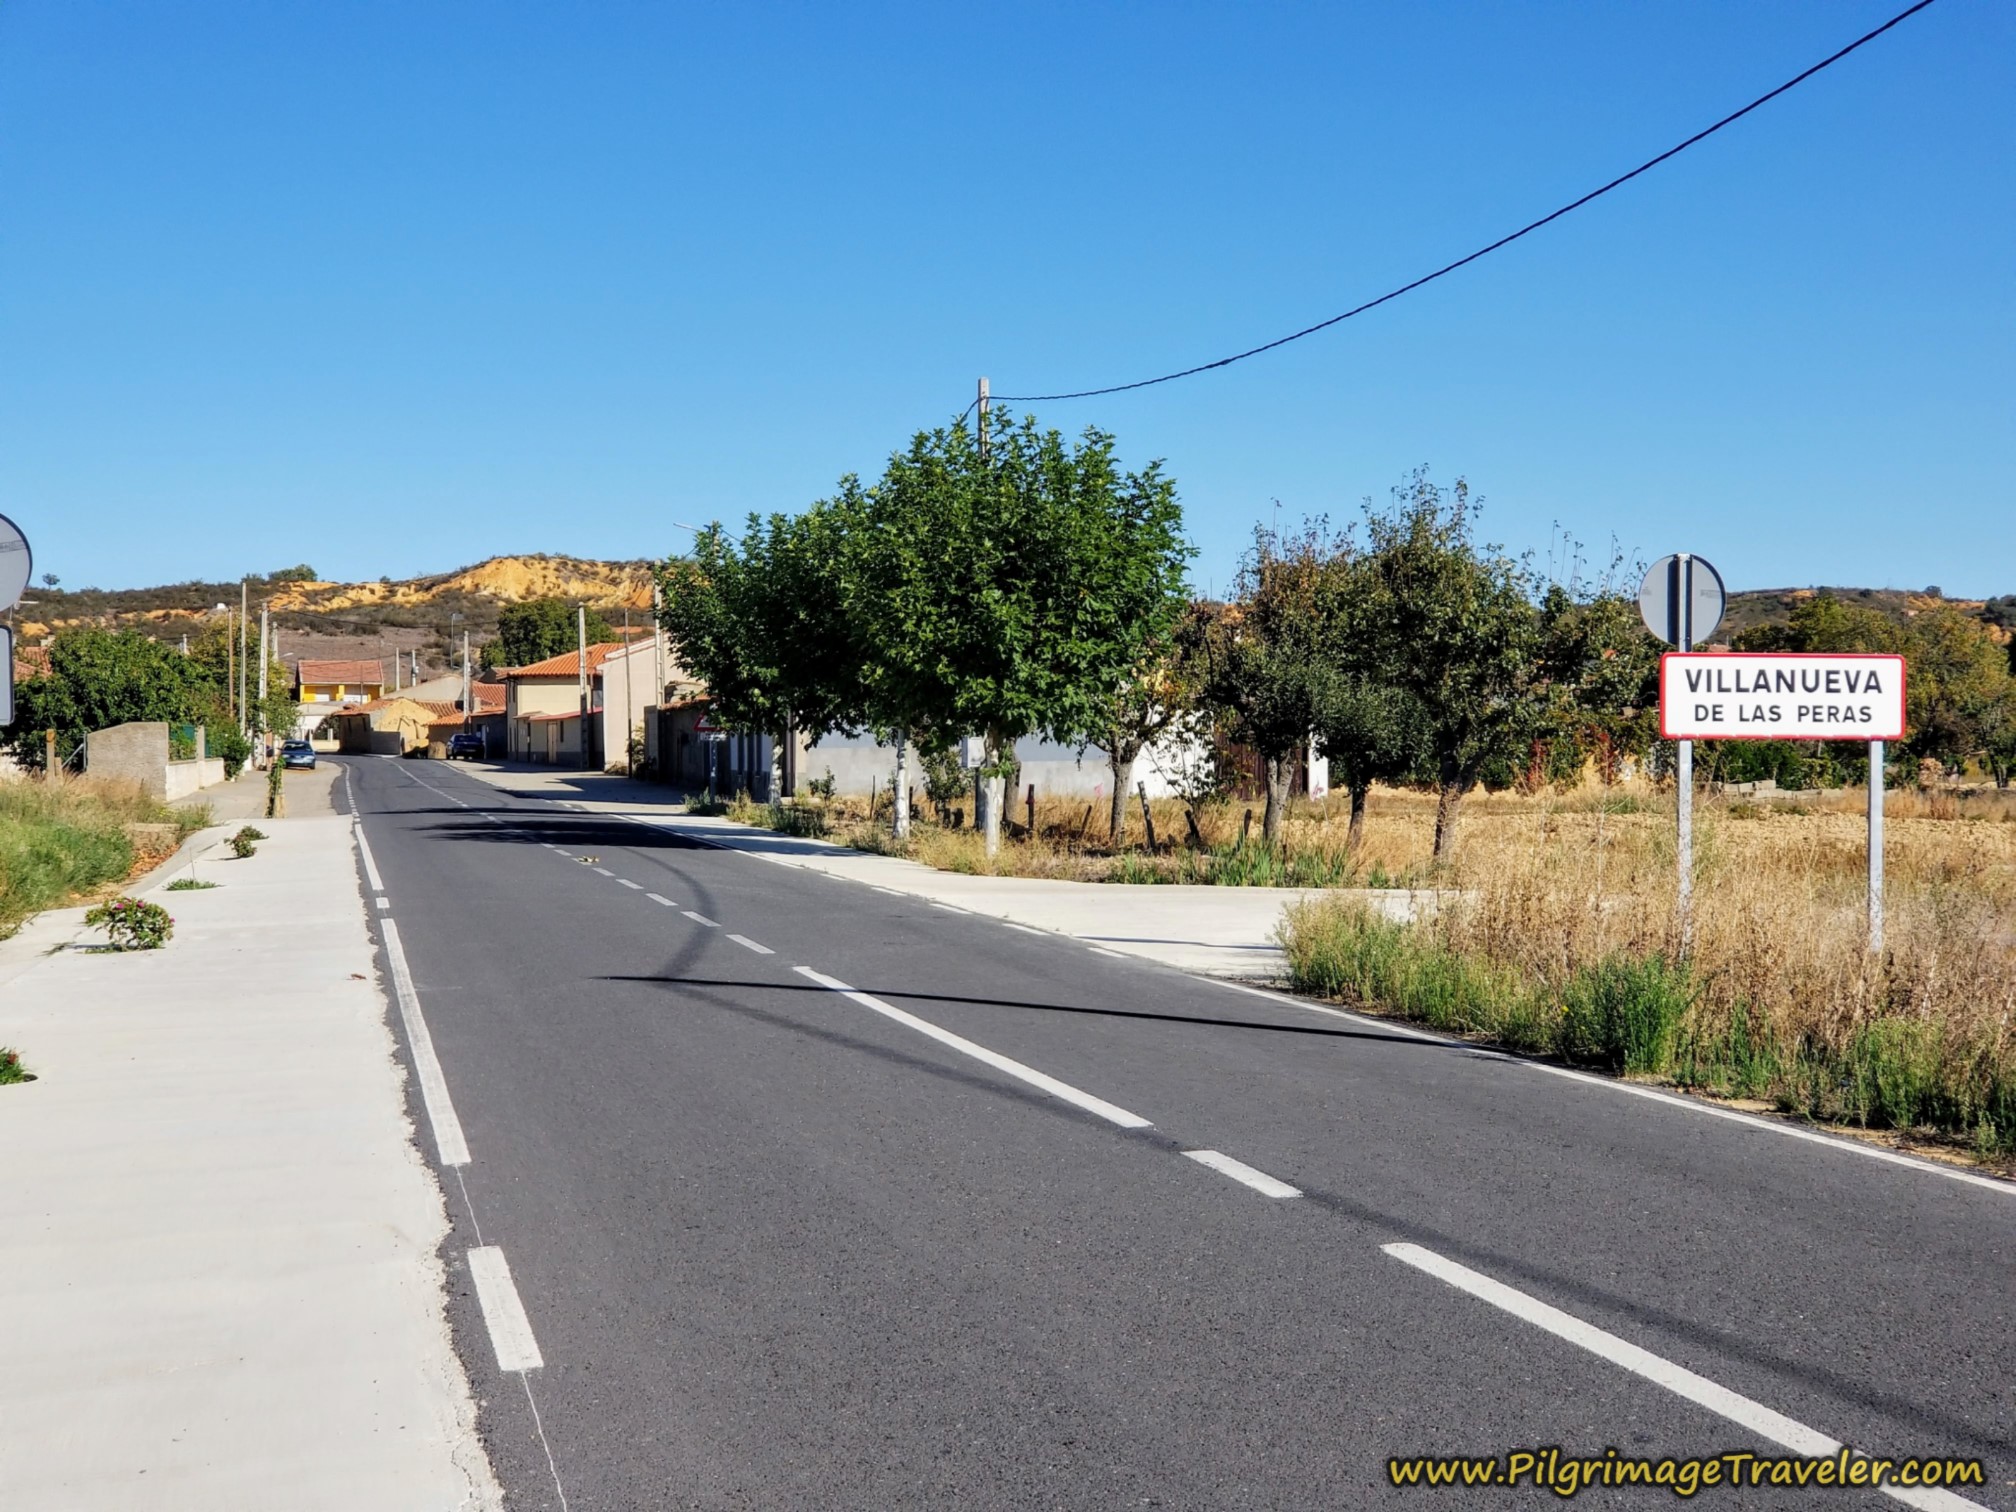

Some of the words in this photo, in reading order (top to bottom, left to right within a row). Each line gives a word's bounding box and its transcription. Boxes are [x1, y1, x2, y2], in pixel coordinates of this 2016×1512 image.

[1685, 669, 1882, 693] VILLANUEVA
[1694, 704, 1724, 722] DE
[1739, 704, 1782, 722] LAS
[1797, 705, 1872, 723] PERAS
